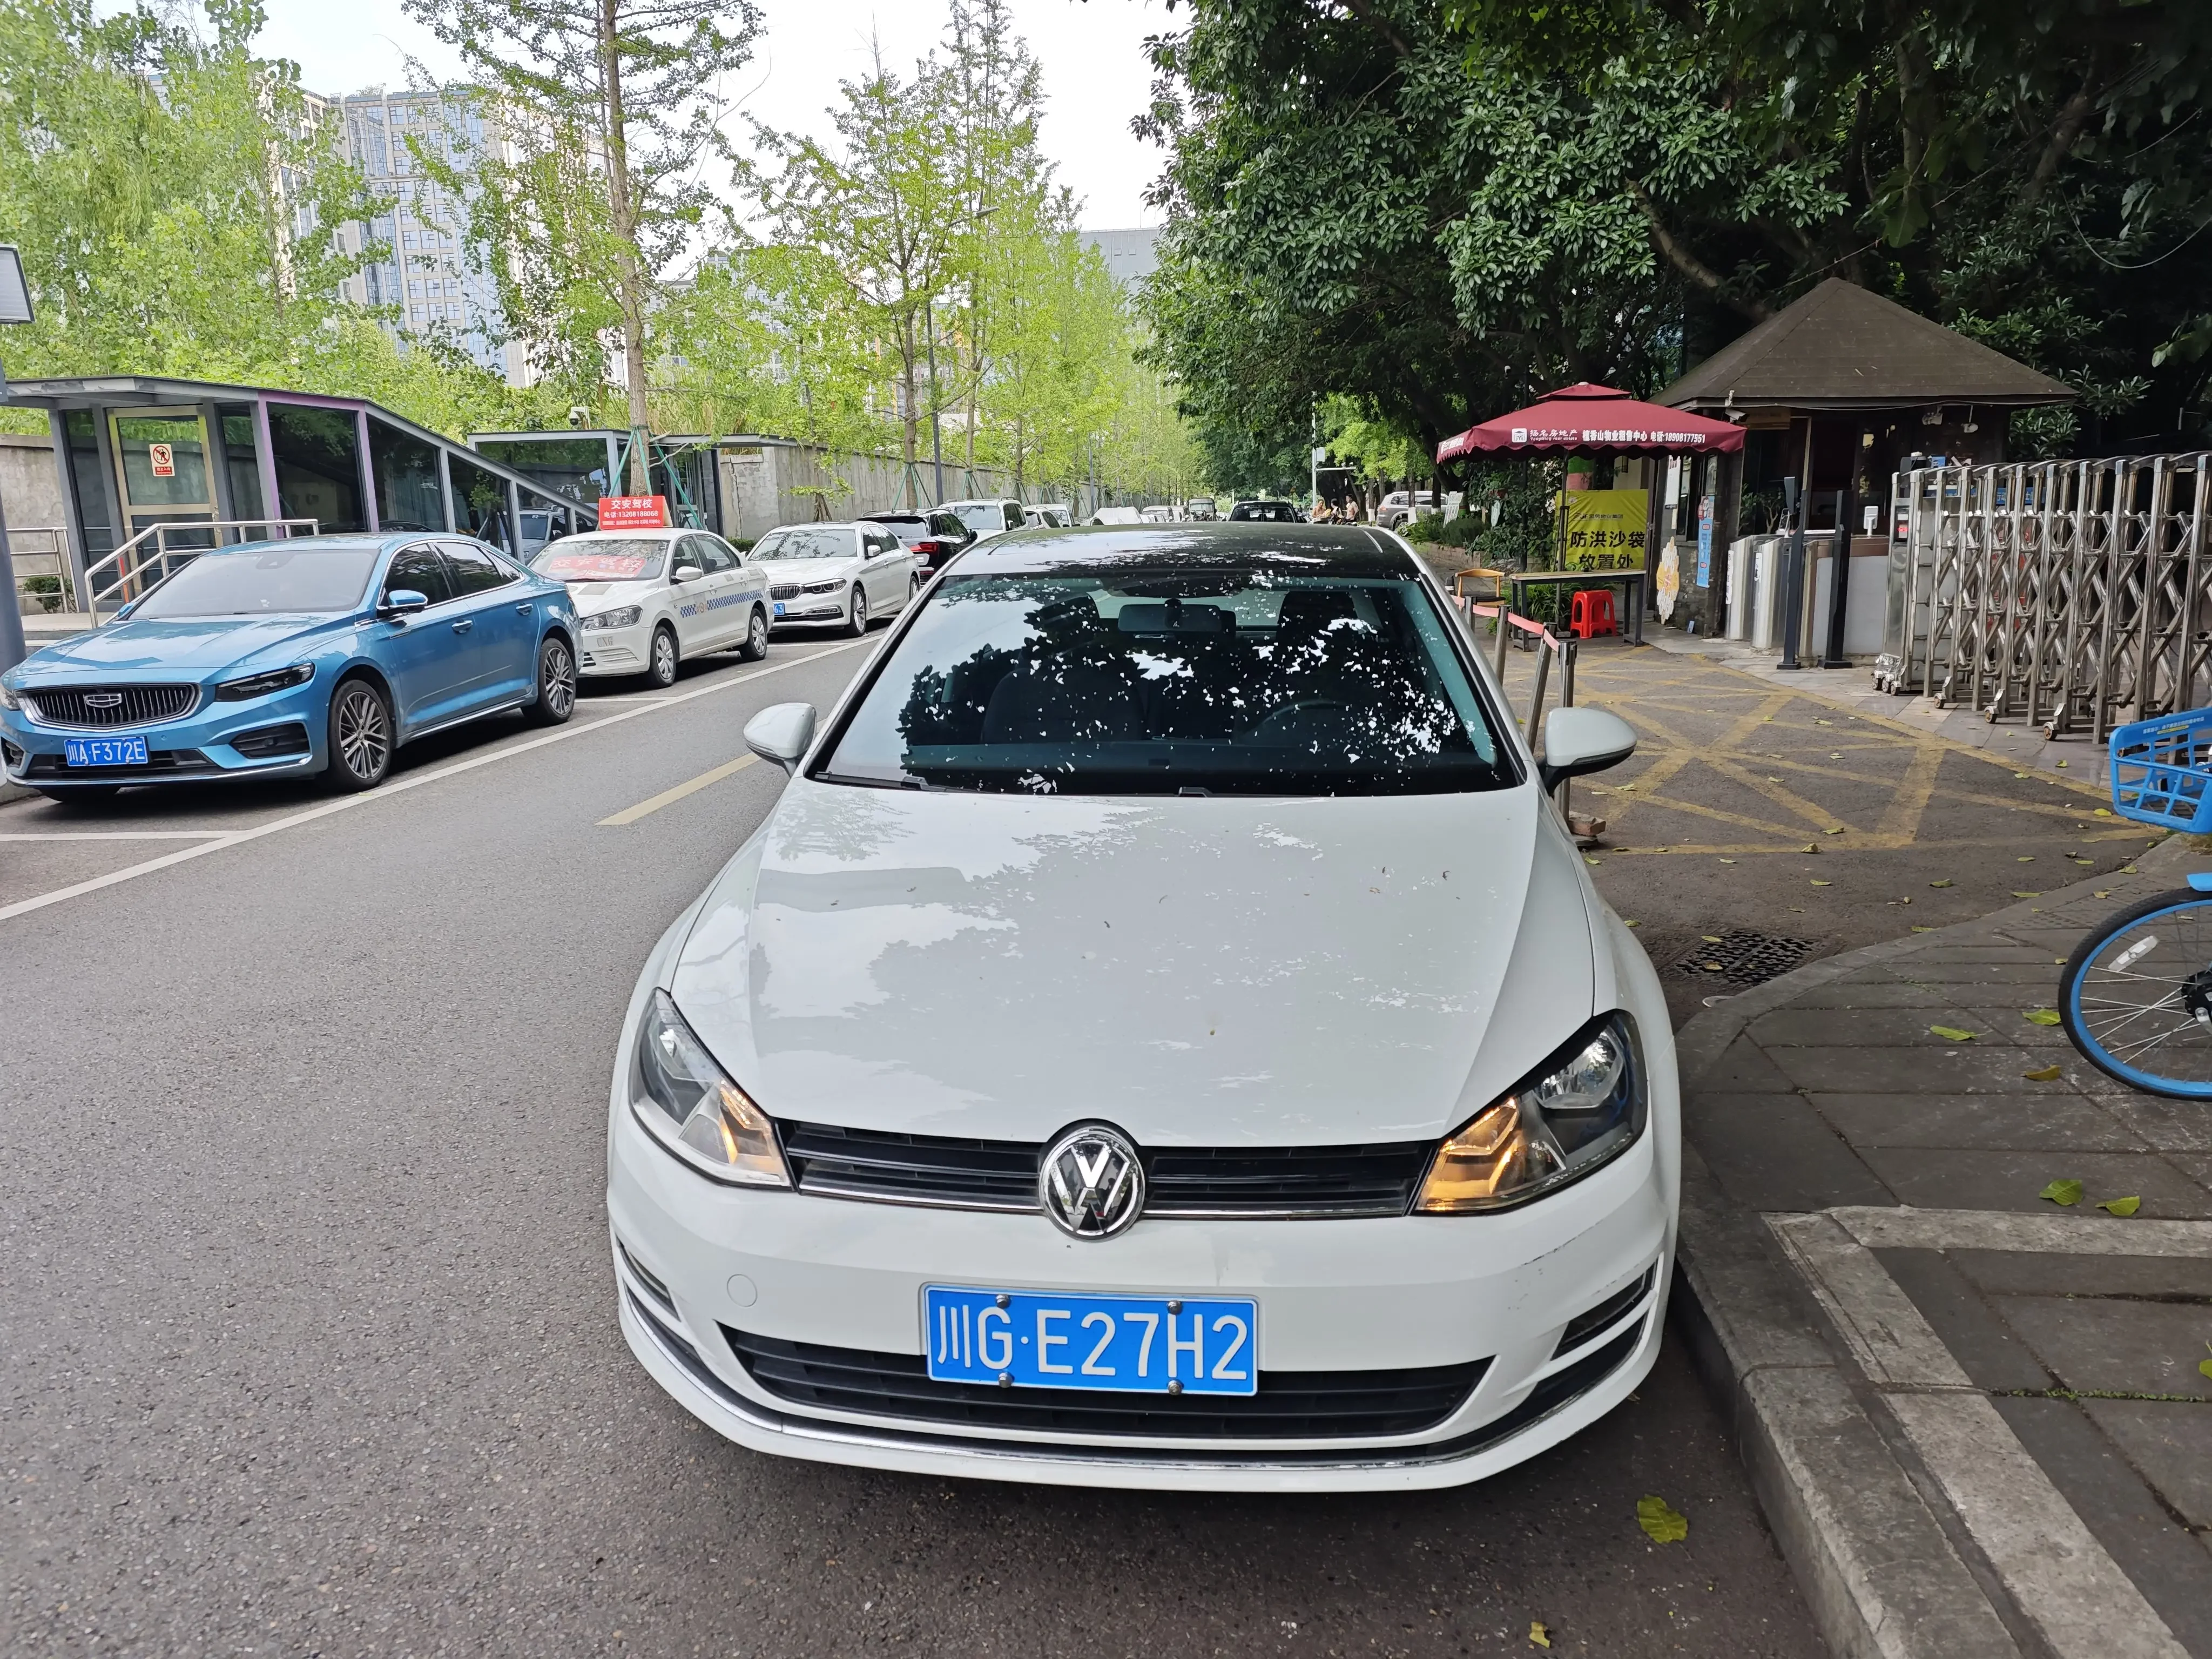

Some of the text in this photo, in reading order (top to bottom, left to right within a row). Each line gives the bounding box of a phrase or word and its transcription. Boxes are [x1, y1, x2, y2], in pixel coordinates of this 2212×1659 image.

[611, 498, 653, 510] 交安驾校
[1570, 530, 1645, 548] 防洪沙袋
[1579, 554, 1634, 570] 放置处
[597, 636, 613, 648] CNG
